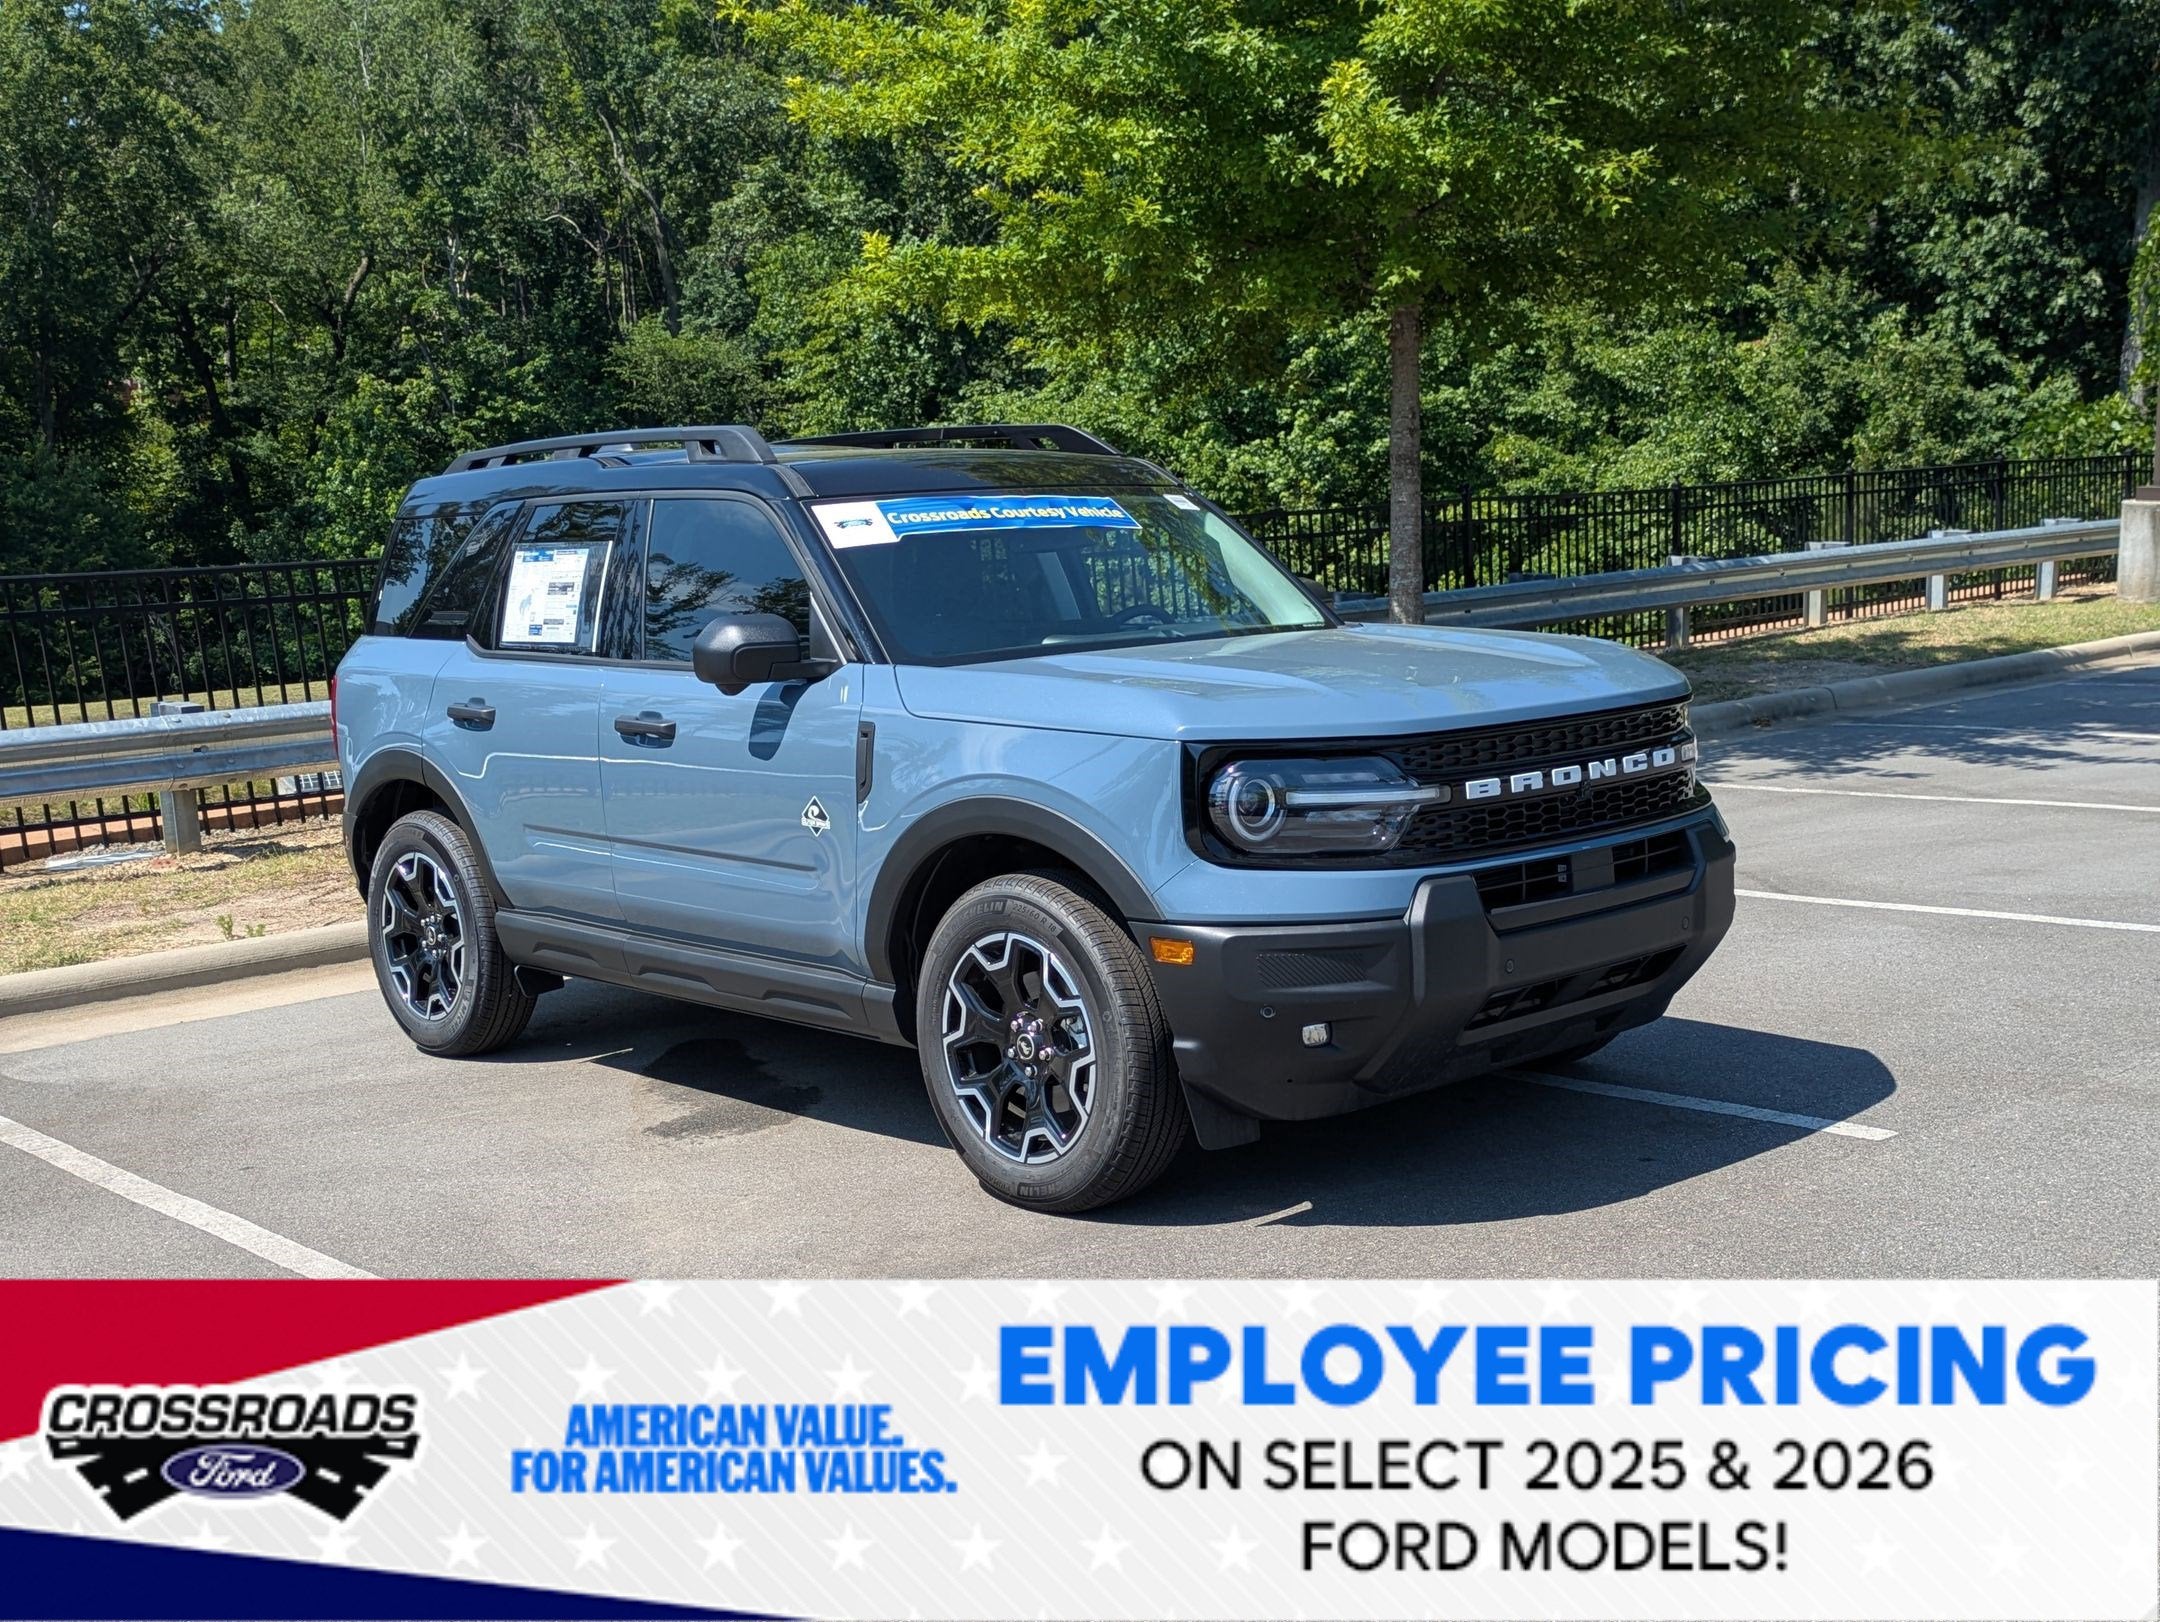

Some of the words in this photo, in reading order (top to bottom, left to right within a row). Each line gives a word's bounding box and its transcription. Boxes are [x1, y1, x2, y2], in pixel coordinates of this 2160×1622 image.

[887, 507, 991, 525] Crossroads
[991, 505, 1065, 522] Courtesy
[1065, 504, 1125, 518] Vehicle
[1465, 747, 1676, 800] BRONCO
[1012, 903, 1040, 920] 225/60
